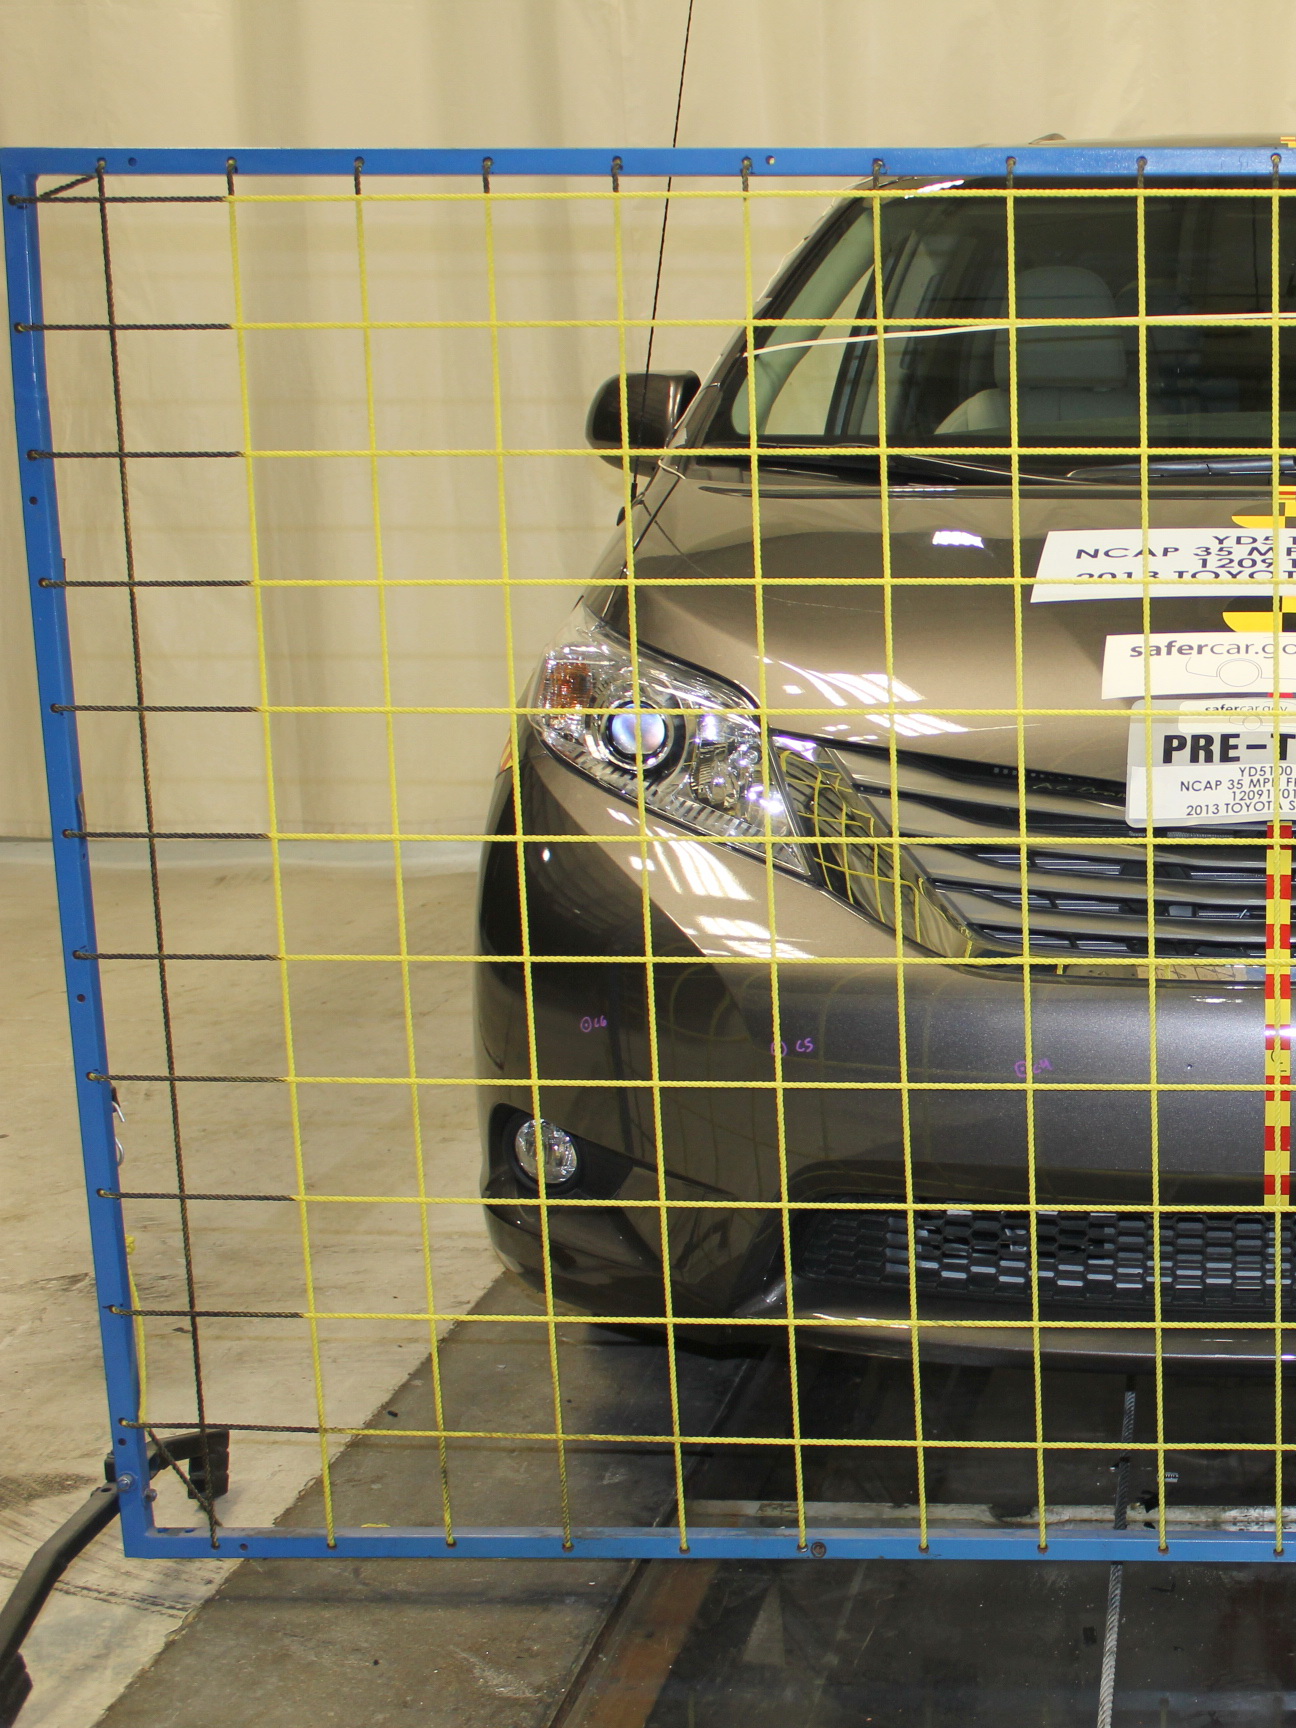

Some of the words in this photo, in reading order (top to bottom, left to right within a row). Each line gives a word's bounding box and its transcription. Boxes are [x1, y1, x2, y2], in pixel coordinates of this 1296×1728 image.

[1075, 546, 1180, 560] NCAP
[1193, 546, 1234, 557] 35
[1205, 703, 1288, 713] safercargv
[1180, 780, 1223, 792] NCAP
[1227, 778, 1244, 790] 35
[1186, 803, 1220, 816] 2013
